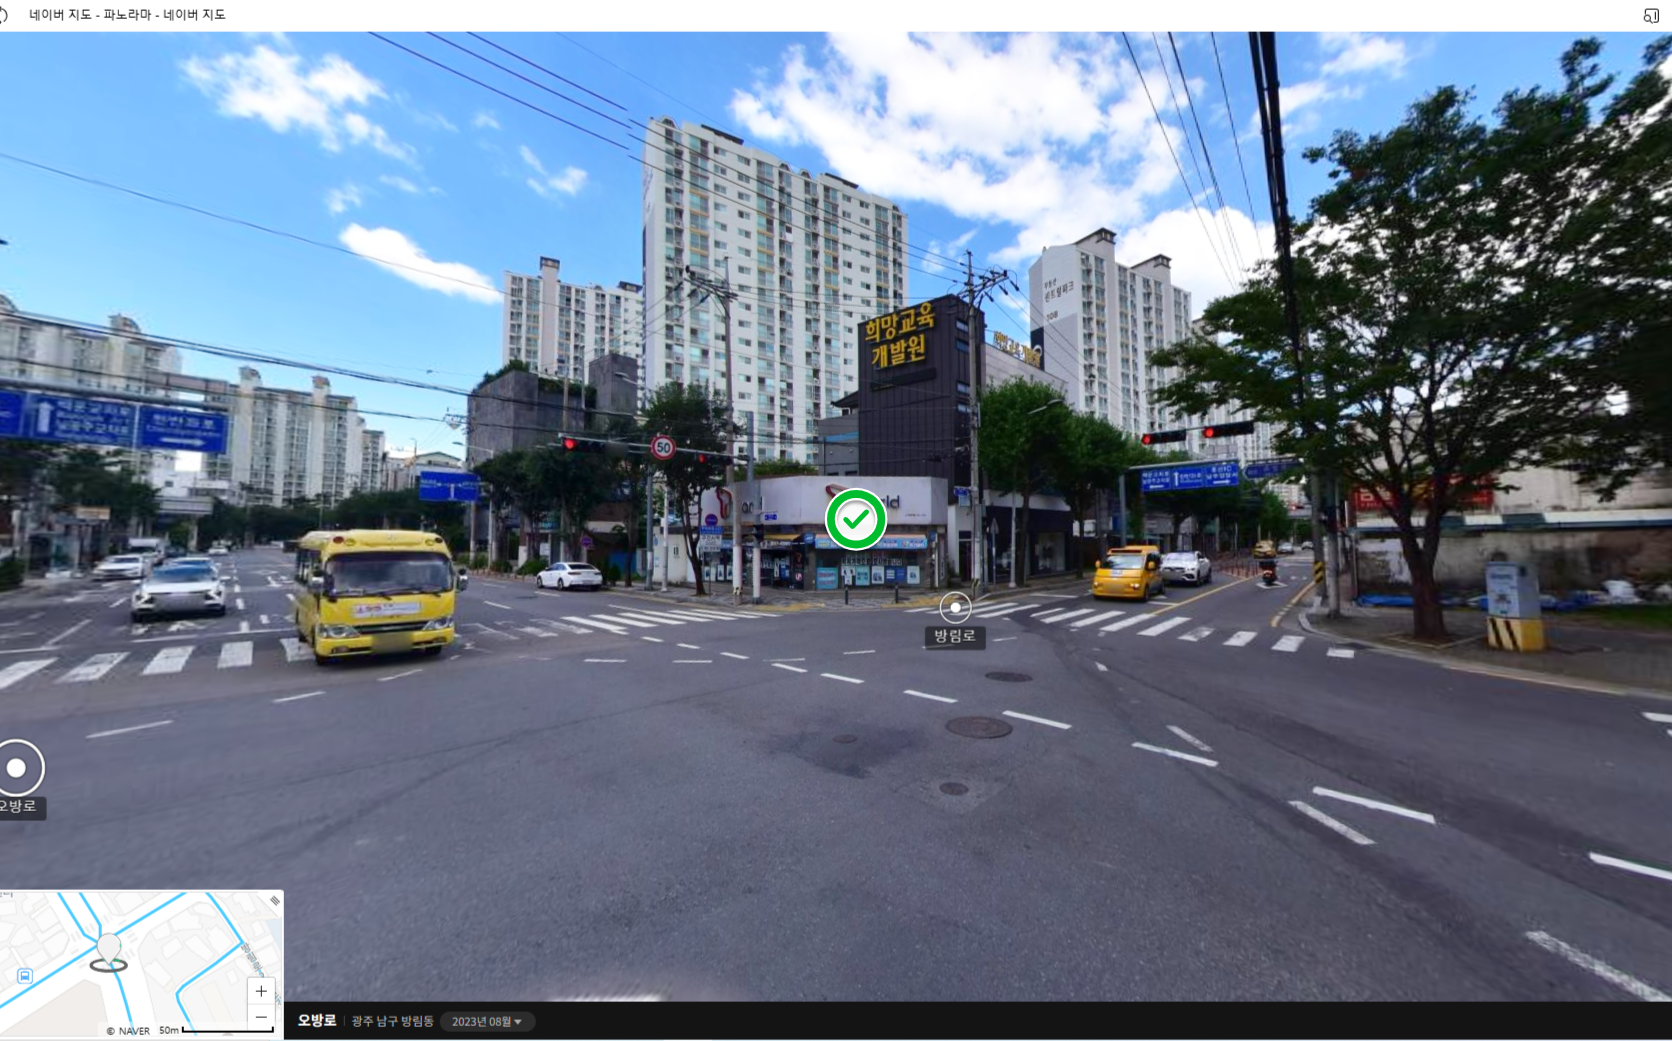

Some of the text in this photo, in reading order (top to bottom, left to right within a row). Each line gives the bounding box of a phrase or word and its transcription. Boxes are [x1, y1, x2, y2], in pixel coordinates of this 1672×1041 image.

[865, 302, 936, 343] 희망교육
[871, 333, 926, 368] 개발원
[657, 442, 671, 454] 50
